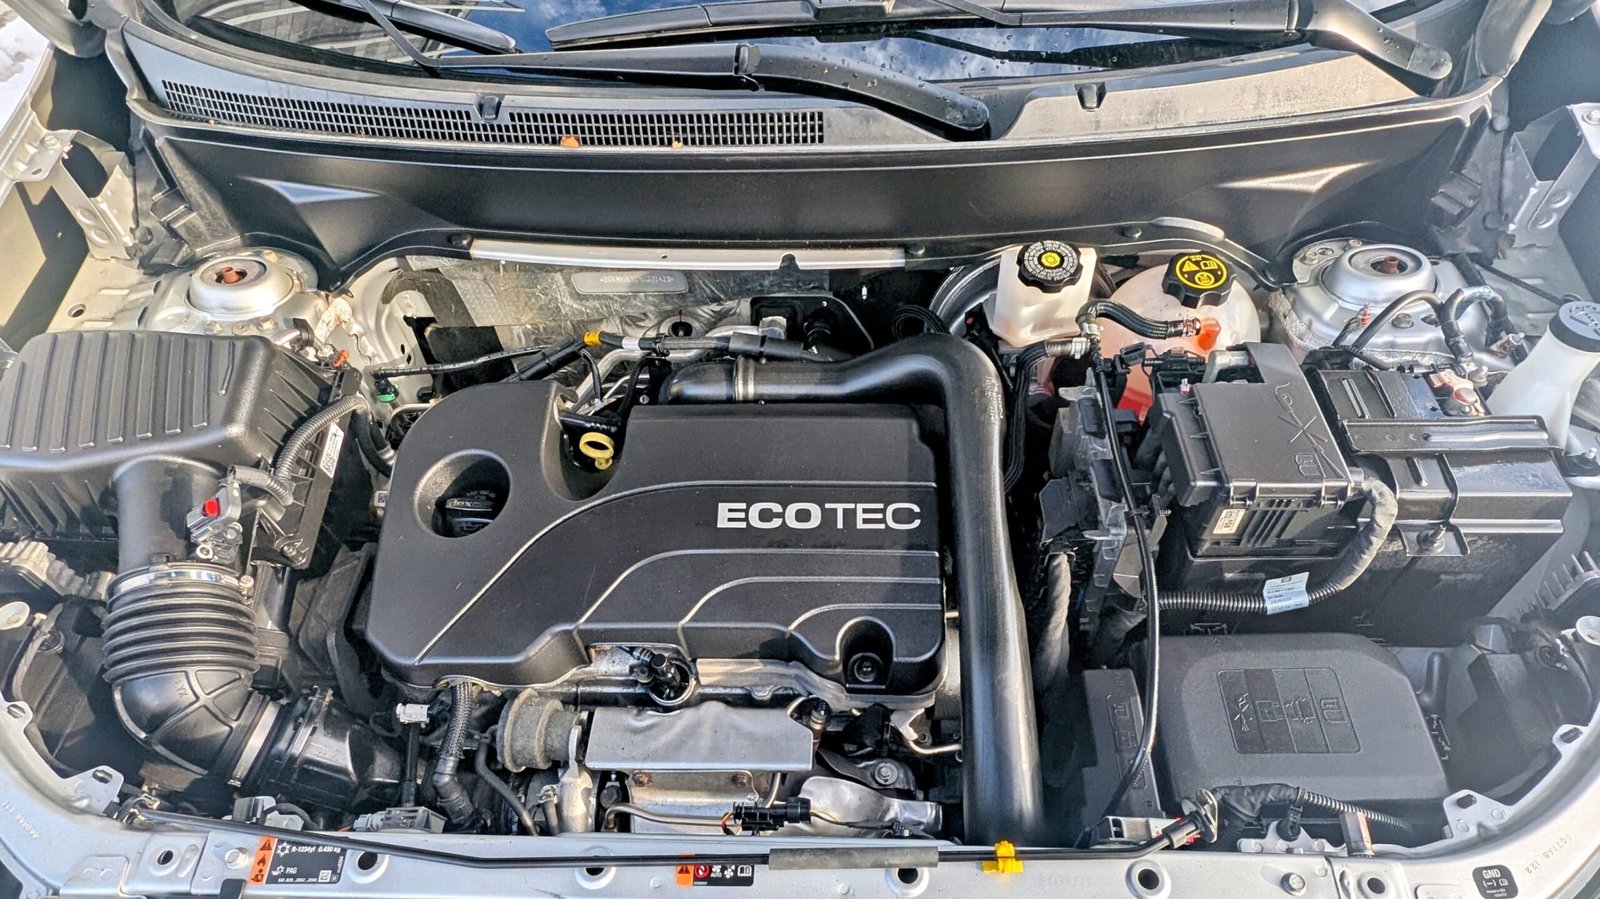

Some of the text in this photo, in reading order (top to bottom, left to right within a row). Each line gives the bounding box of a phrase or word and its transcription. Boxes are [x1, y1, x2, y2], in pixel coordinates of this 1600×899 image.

[717, 502, 921, 530] ECOTEC
[333, 846, 341, 854] kg
[1482, 868, 1501, 879] GND
